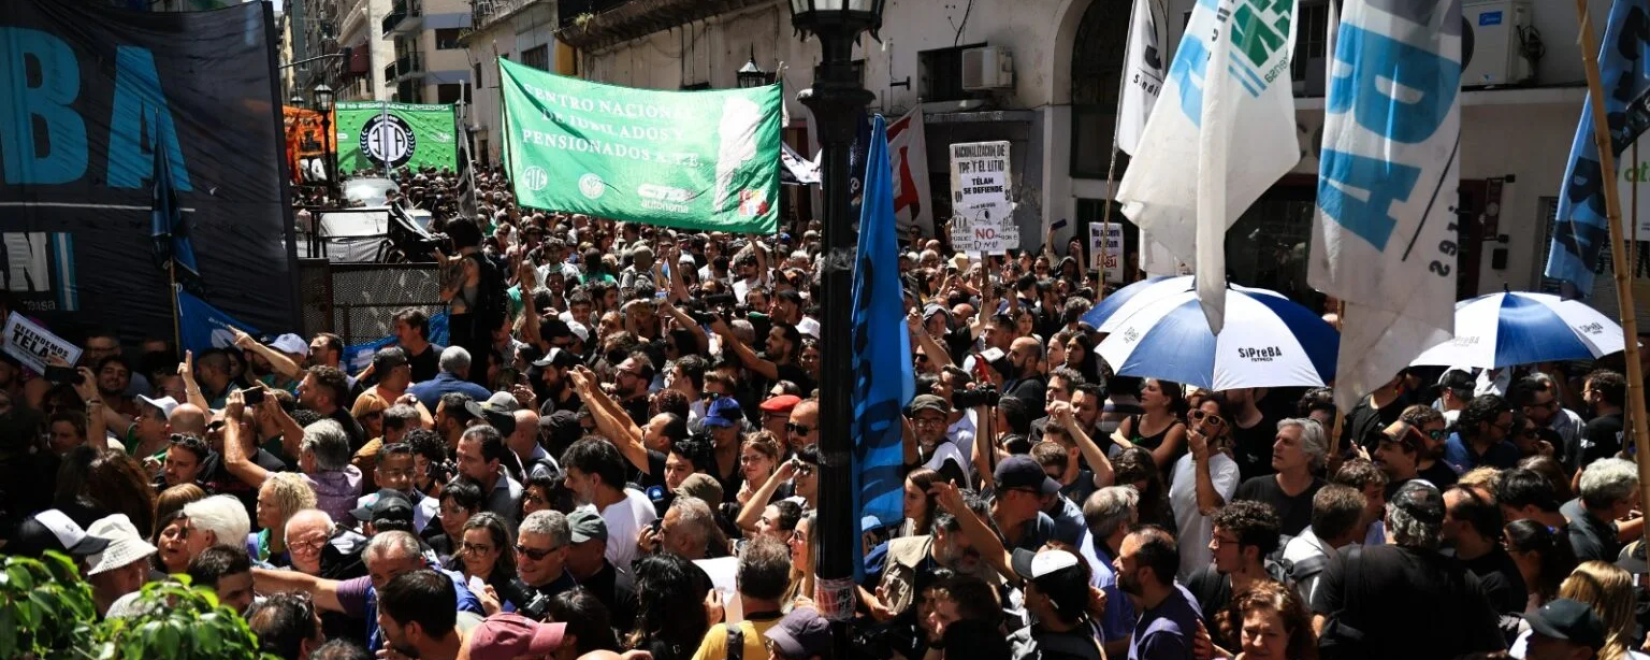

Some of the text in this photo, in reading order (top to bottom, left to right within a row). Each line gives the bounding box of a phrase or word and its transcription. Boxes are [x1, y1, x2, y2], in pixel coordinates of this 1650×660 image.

[522, 83, 595, 112] CENTRO
[0, 26, 193, 191] BA
[522, 128, 650, 161] PENSIONADOS
[971, 161, 979, 173] Y
[979, 160, 986, 173] EL
[987, 159, 1005, 173] LITIO
[971, 176, 994, 186] TÉLAM
[963, 185, 1003, 195] SE DEFIENDE
[975, 228, 996, 240] NO
[15, 322, 70, 358] DEFENDEMOS
[1237, 346, 1282, 358] SiPreBA
